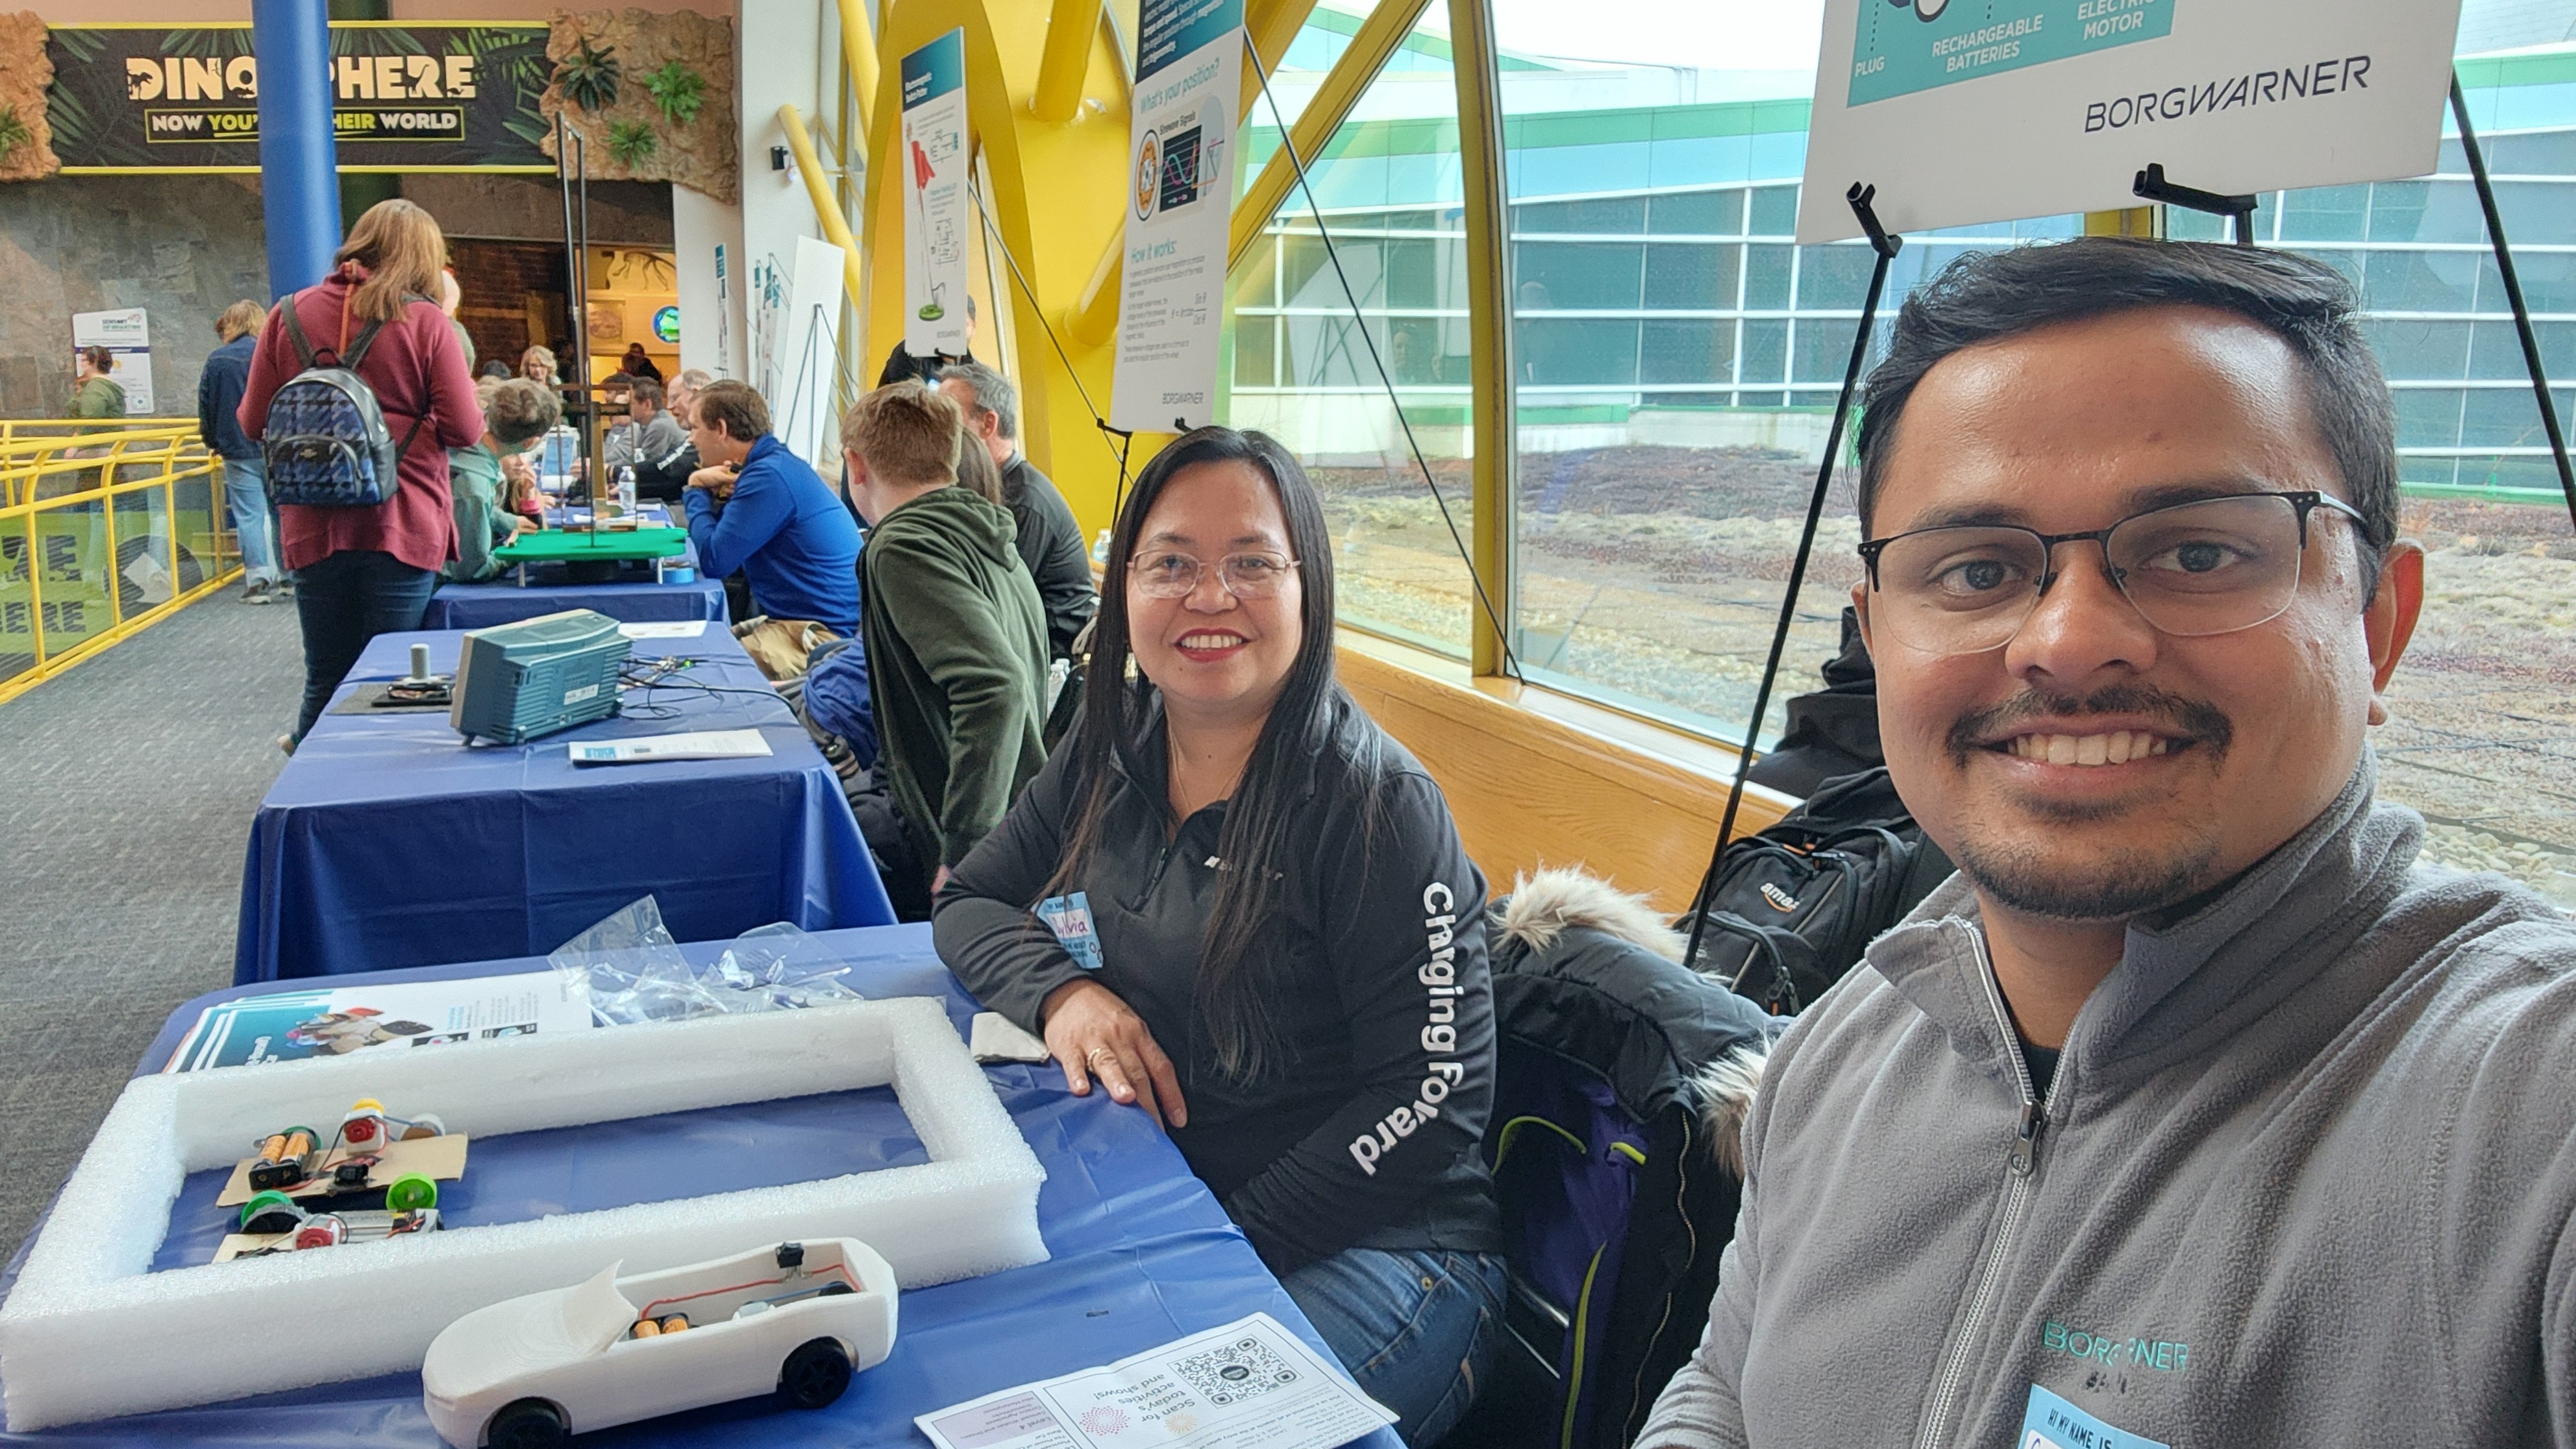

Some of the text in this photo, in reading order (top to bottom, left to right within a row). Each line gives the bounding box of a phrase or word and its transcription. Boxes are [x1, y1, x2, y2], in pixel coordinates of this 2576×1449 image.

[2077, 0, 2155, 20] ELECT
[1932, 14, 2044, 57] RECHARGEABLE
[2084, 10, 2144, 40] MOTOR
[1855, 56, 1885, 77] PLUG
[1946, 42, 2020, 73] BATTERIES
[126, 56, 477, 99] DINOHERE
[2085, 56, 2371, 132] BORGWARNER
[153, 113, 457, 131] NOW YOU' HEIR WORLD
[1093, 1374, 1165, 1400] and shows!
[1117, 1381, 1176, 1405] activities
[1138, 1390, 1185, 1412] today's
[1141, 1398, 1195, 1422] Scan for
[1026, 1417, 1053, 1427] Level
[2048, 1408, 2059, 1427] HI
[2057, 1415, 2070, 1434] MY
[2068, 1422, 2094, 1449] NAME
